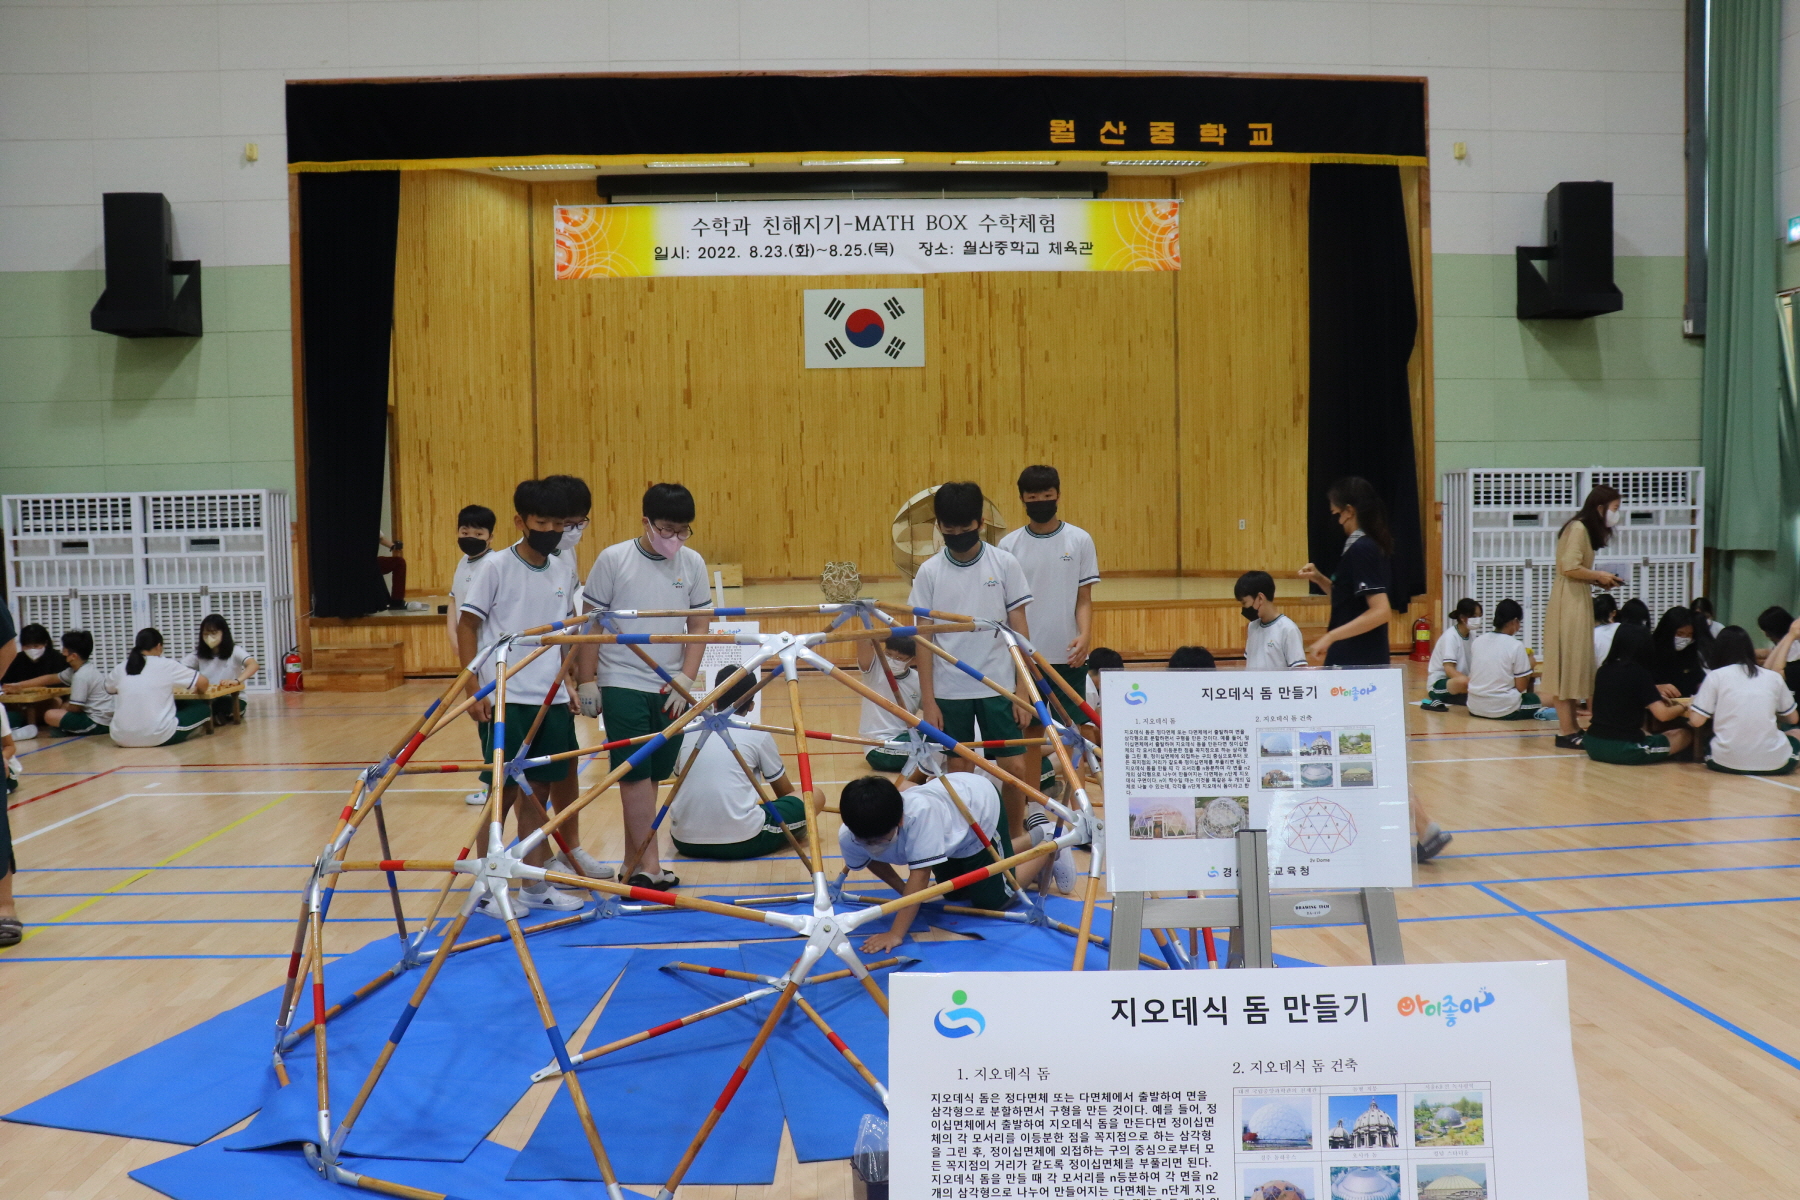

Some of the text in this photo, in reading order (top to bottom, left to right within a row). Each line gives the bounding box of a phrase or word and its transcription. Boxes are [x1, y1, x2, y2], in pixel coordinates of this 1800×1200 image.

[1050, 119, 1273, 146] 월산중학교
[691, 213, 1055, 237] 수학과 친해지기-MATH BOX 수학체험
[654, 242, 895, 261] 일시: 2022. 8.23.(화)~8.25.(목)
[918, 240, 1094, 257] 장소: 월산중학교 체육관
[1201, 685, 1318, 701] 지오데식 돔 만들기
[1330, 684, 1377, 701] 아이좋아
[1142, 717, 1168, 725] 지오데식
[1255, 715, 1262, 723] 2.
[1263, 714, 1289, 723] 지오데식
[1299, 714, 1313, 722] 건축
[1111, 992, 1369, 1027] 지오데식 돔 만들기
[1397, 988, 1495, 1027] 아이좋아
[1232, 1058, 1358, 1075] 2. 지오데식 돔 건축
[957, 1067, 1051, 1082] 1. 지오데식 돔
[931, 1090, 1207, 1104] 지오데식 돔은 정다면체 또는 다면체에서 출발하여 면을
[931, 1103, 1217, 1118] 삼각형으로 분할하면서 구형을 만든 것이다. 예를 들어, 정
[931, 1116, 1214, 1131] 이십면체에서 출발하여 지오데식 돔을 만든다면 정이십면
[931, 1129, 1211, 1145] 체의 각 모서리를 이등분한 점을 꼭지점으로 하는 삼각형
[931, 1143, 1215, 1158] 을 그린 후, 정이십면체에 외접하는 구의 중심으로부터 모
[931, 1157, 1211, 1172] 든 꼭지점의 거리가 같도록 정이십면체를 부풀리면 된다.
[931, 1170, 1218, 1185] 지오데식 돔을 만들 때 각 모서리를 n등분하여 각 면을 n2
[931, 1184, 1216, 1199] 개의 삼각형으로 나누어 만들어지는 다면체는 n단계 지오
